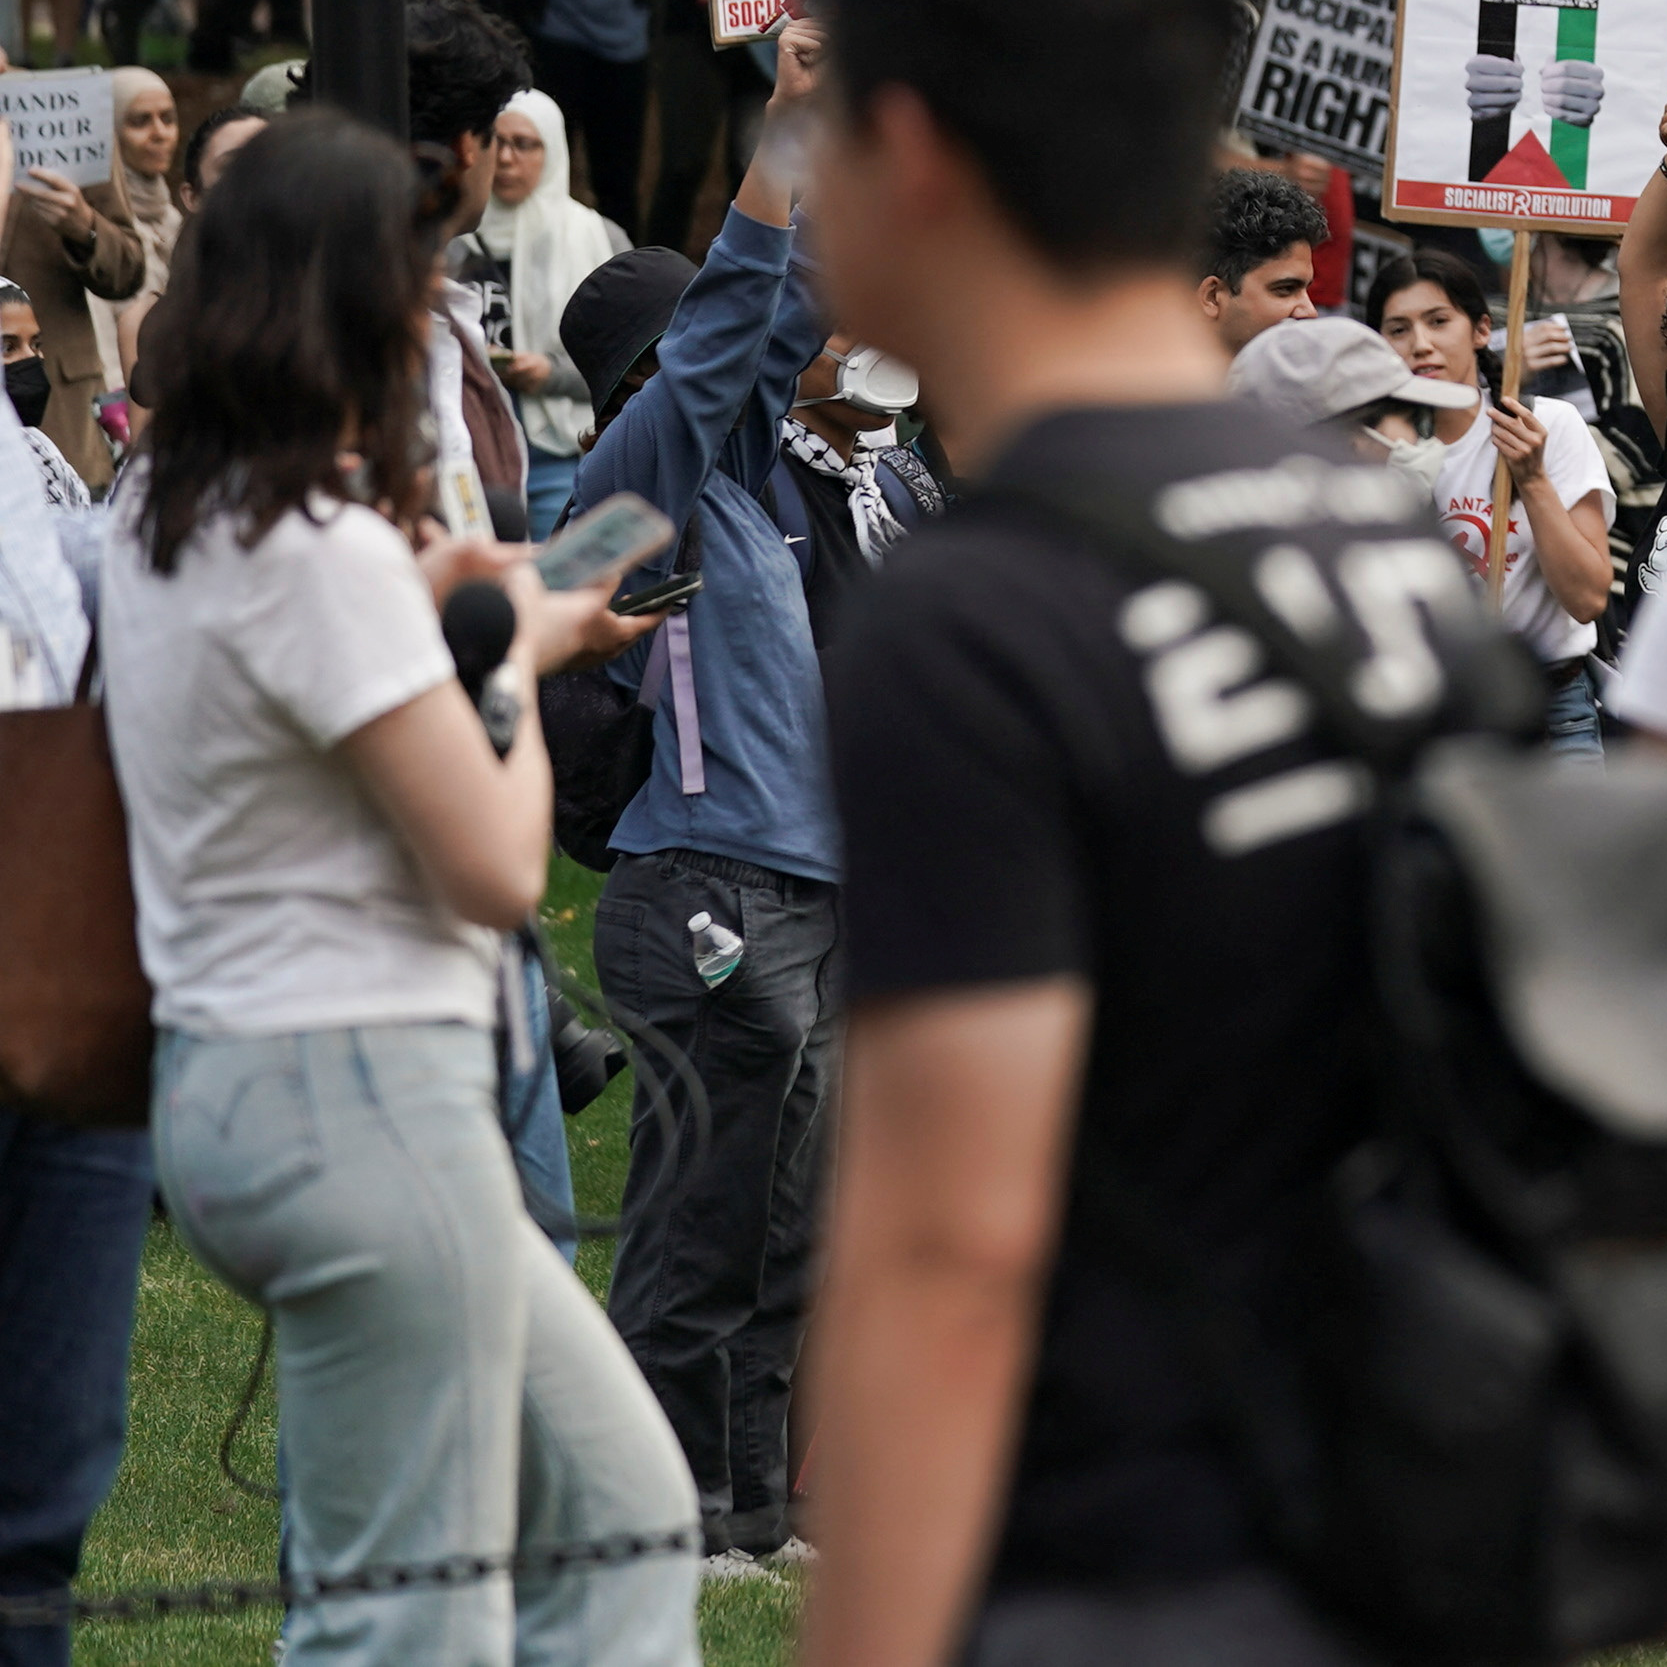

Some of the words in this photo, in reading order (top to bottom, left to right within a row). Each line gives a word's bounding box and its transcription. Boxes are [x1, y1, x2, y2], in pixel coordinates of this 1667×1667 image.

[38, 117, 92, 141] OUR
[1443, 186, 1515, 213] SOCIALIST
[1531, 192, 1612, 219] REVOLUTION
